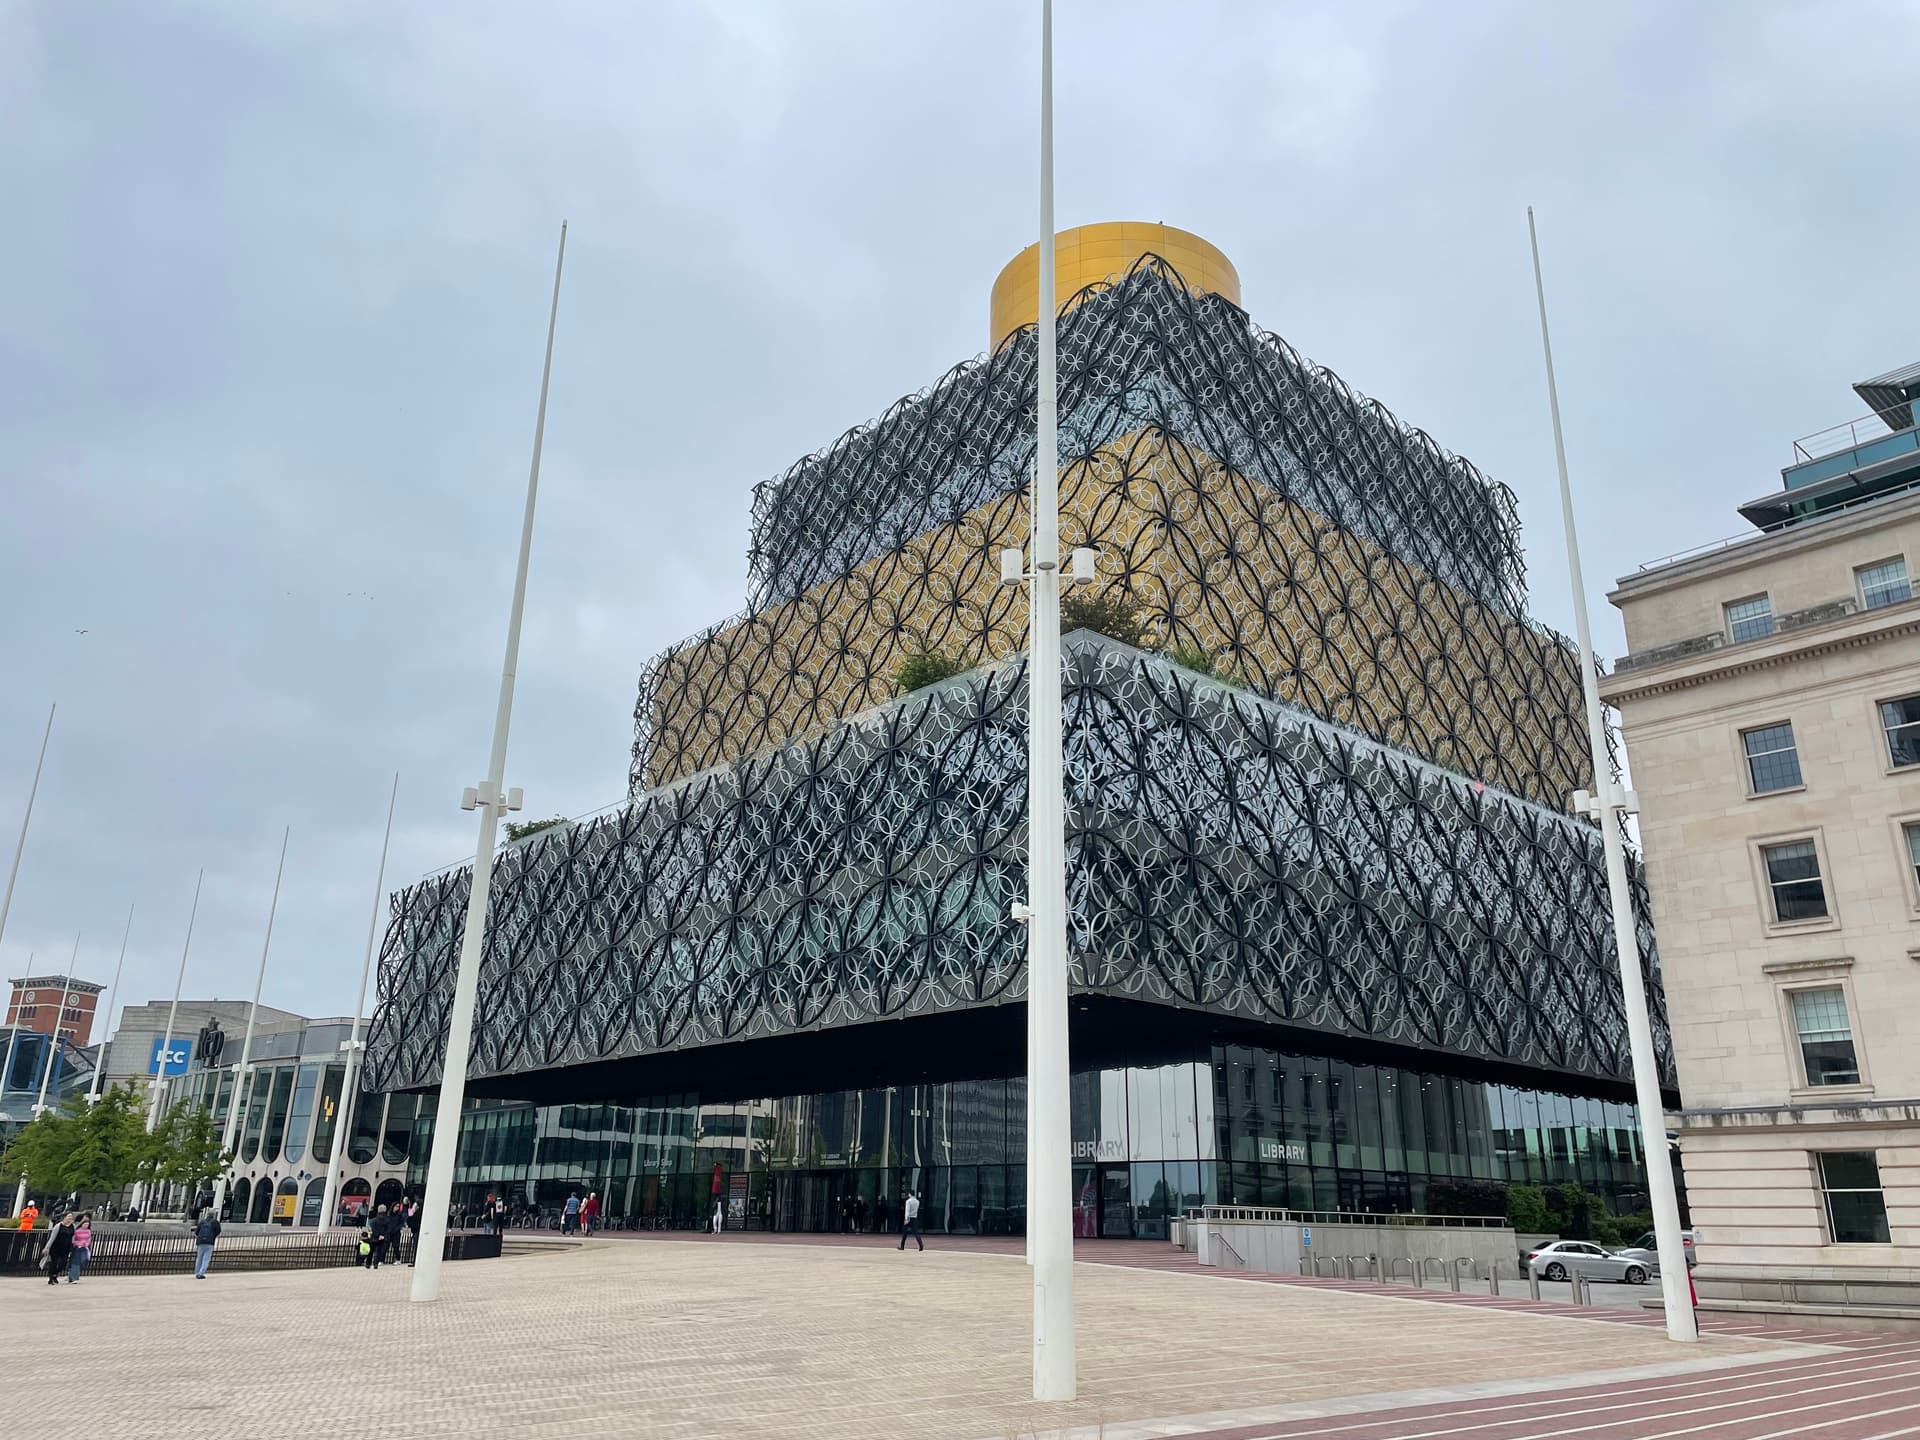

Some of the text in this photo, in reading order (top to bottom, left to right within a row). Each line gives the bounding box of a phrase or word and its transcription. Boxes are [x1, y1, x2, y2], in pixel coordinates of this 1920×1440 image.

[156, 1050, 185, 1063] ICC
[1071, 1140, 1123, 1158] IBRARY
[1261, 1143, 1305, 1160] LIBRARY
[643, 1160, 660, 1168] Library
